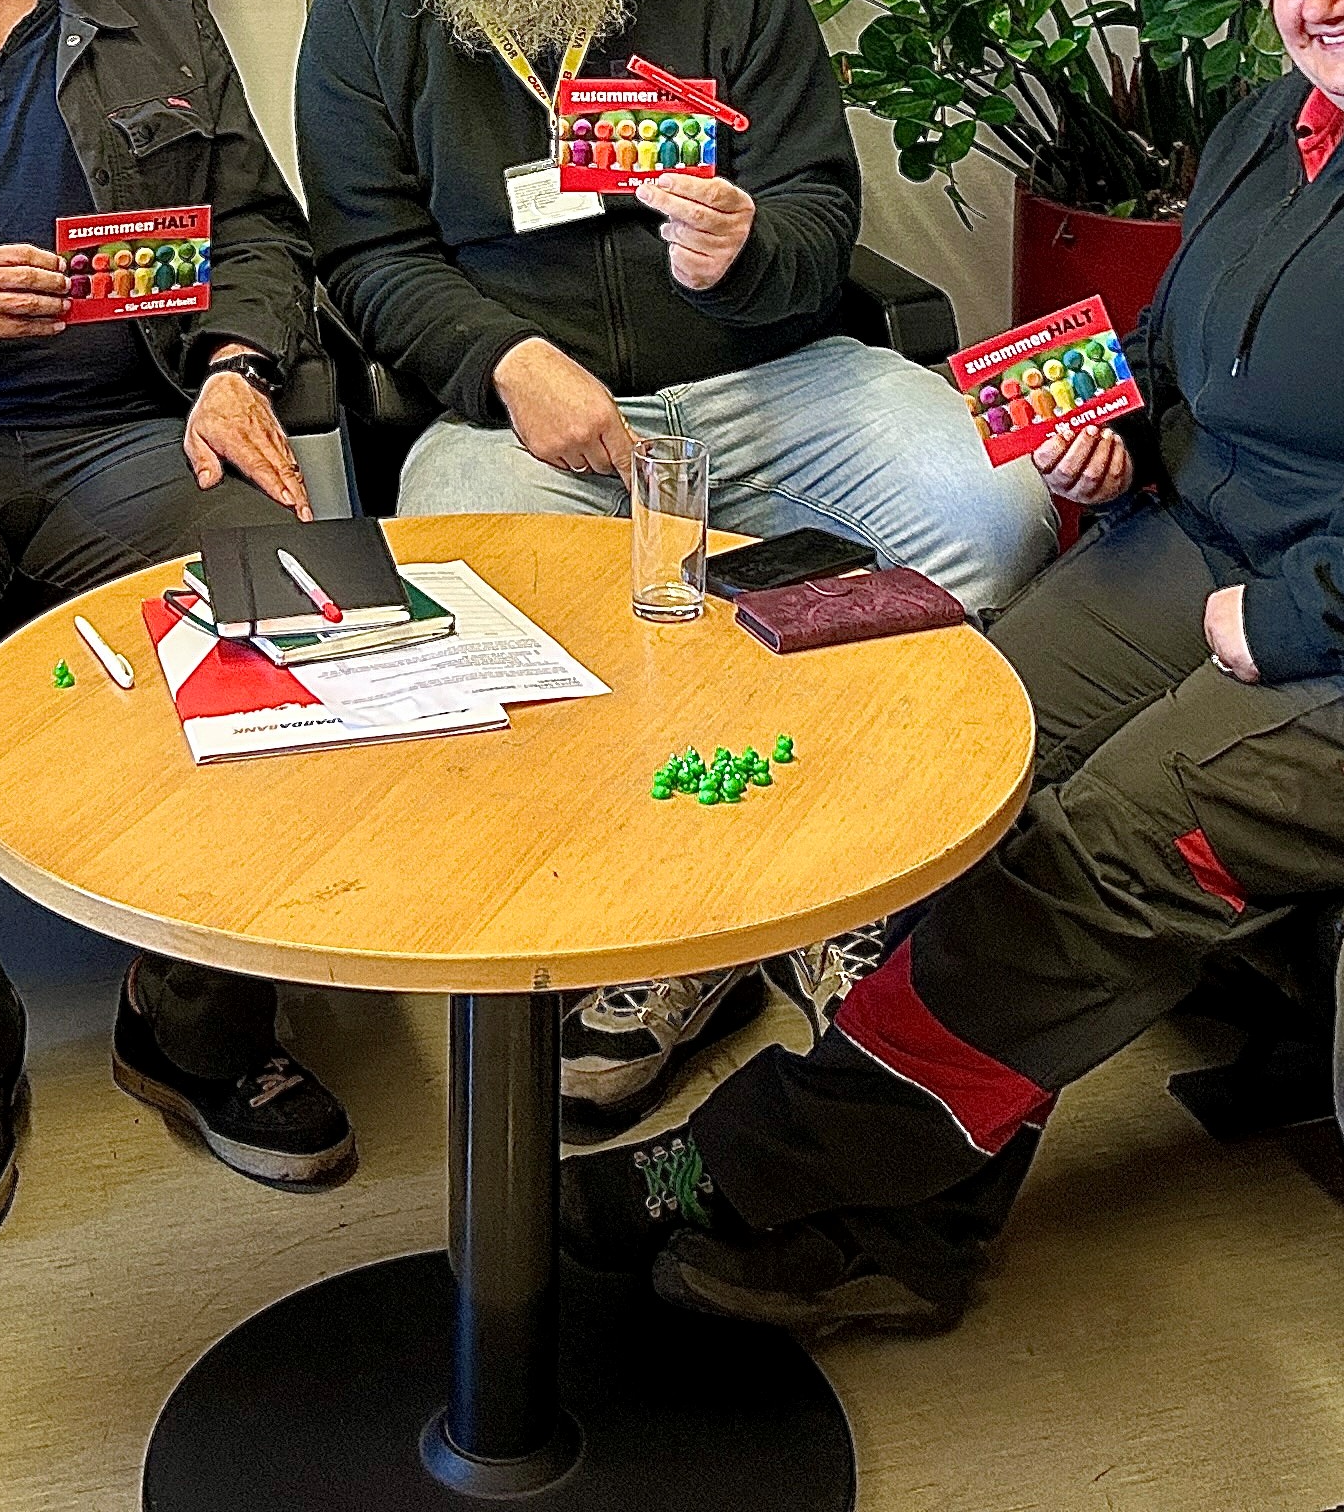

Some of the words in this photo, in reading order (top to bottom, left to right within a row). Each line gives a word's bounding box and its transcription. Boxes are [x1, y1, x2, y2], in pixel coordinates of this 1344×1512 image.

[68, 214, 198, 239] zusammenHALT
[125, 303, 139, 312] für
[140, 300, 165, 310] GUTE
[166, 296, 197, 308] Arbeit!
[964, 308, 1093, 374] zusammenHALT
[1070, 410, 1097, 427] GUTE
